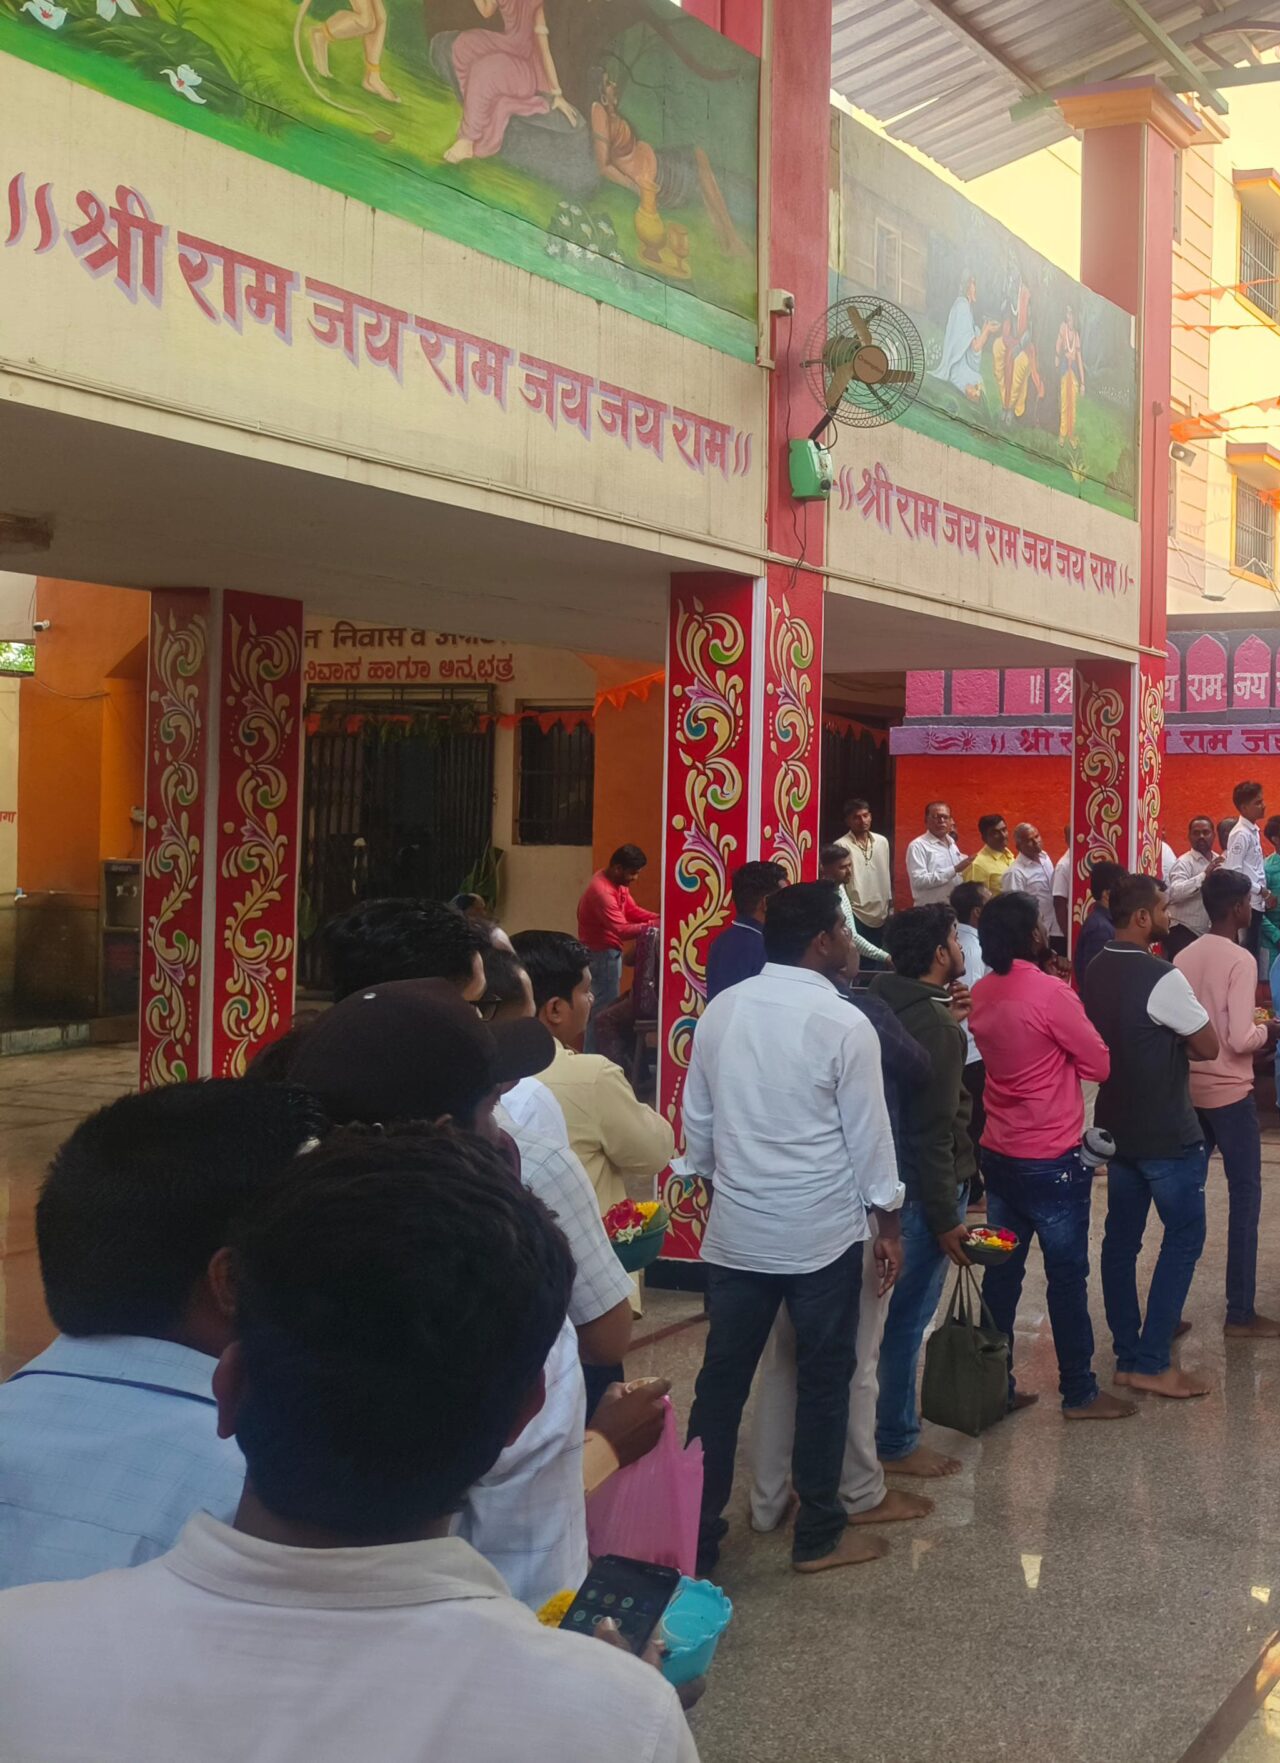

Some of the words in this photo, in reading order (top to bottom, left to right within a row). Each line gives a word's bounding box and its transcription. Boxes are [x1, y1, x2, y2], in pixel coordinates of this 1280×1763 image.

[65, 184, 168, 308] श्री
[177, 230, 301, 346] राम
[305, 277, 408, 381] जय
[414, 314, 514, 412] राम
[518, 353, 597, 438] जय
[597, 380, 668, 463] जय
[672, 405, 737, 481] राम
[856, 461, 893, 534] श्री
[896, 484, 941, 547] राम
[942, 502, 983, 558] जय
[984, 516, 1020, 568] राम
[1021, 529, 1054, 577] जय
[1055, 540, 1086, 592] जय
[1089, 552, 1118, 598] राम
[331, 620, 407, 649] निवास
[1187, 673, 1223, 702] राम
[1233, 671, 1269, 700] जय
[1019, 728, 1053, 753] श्री
[1179, 729, 1232, 753] राम
